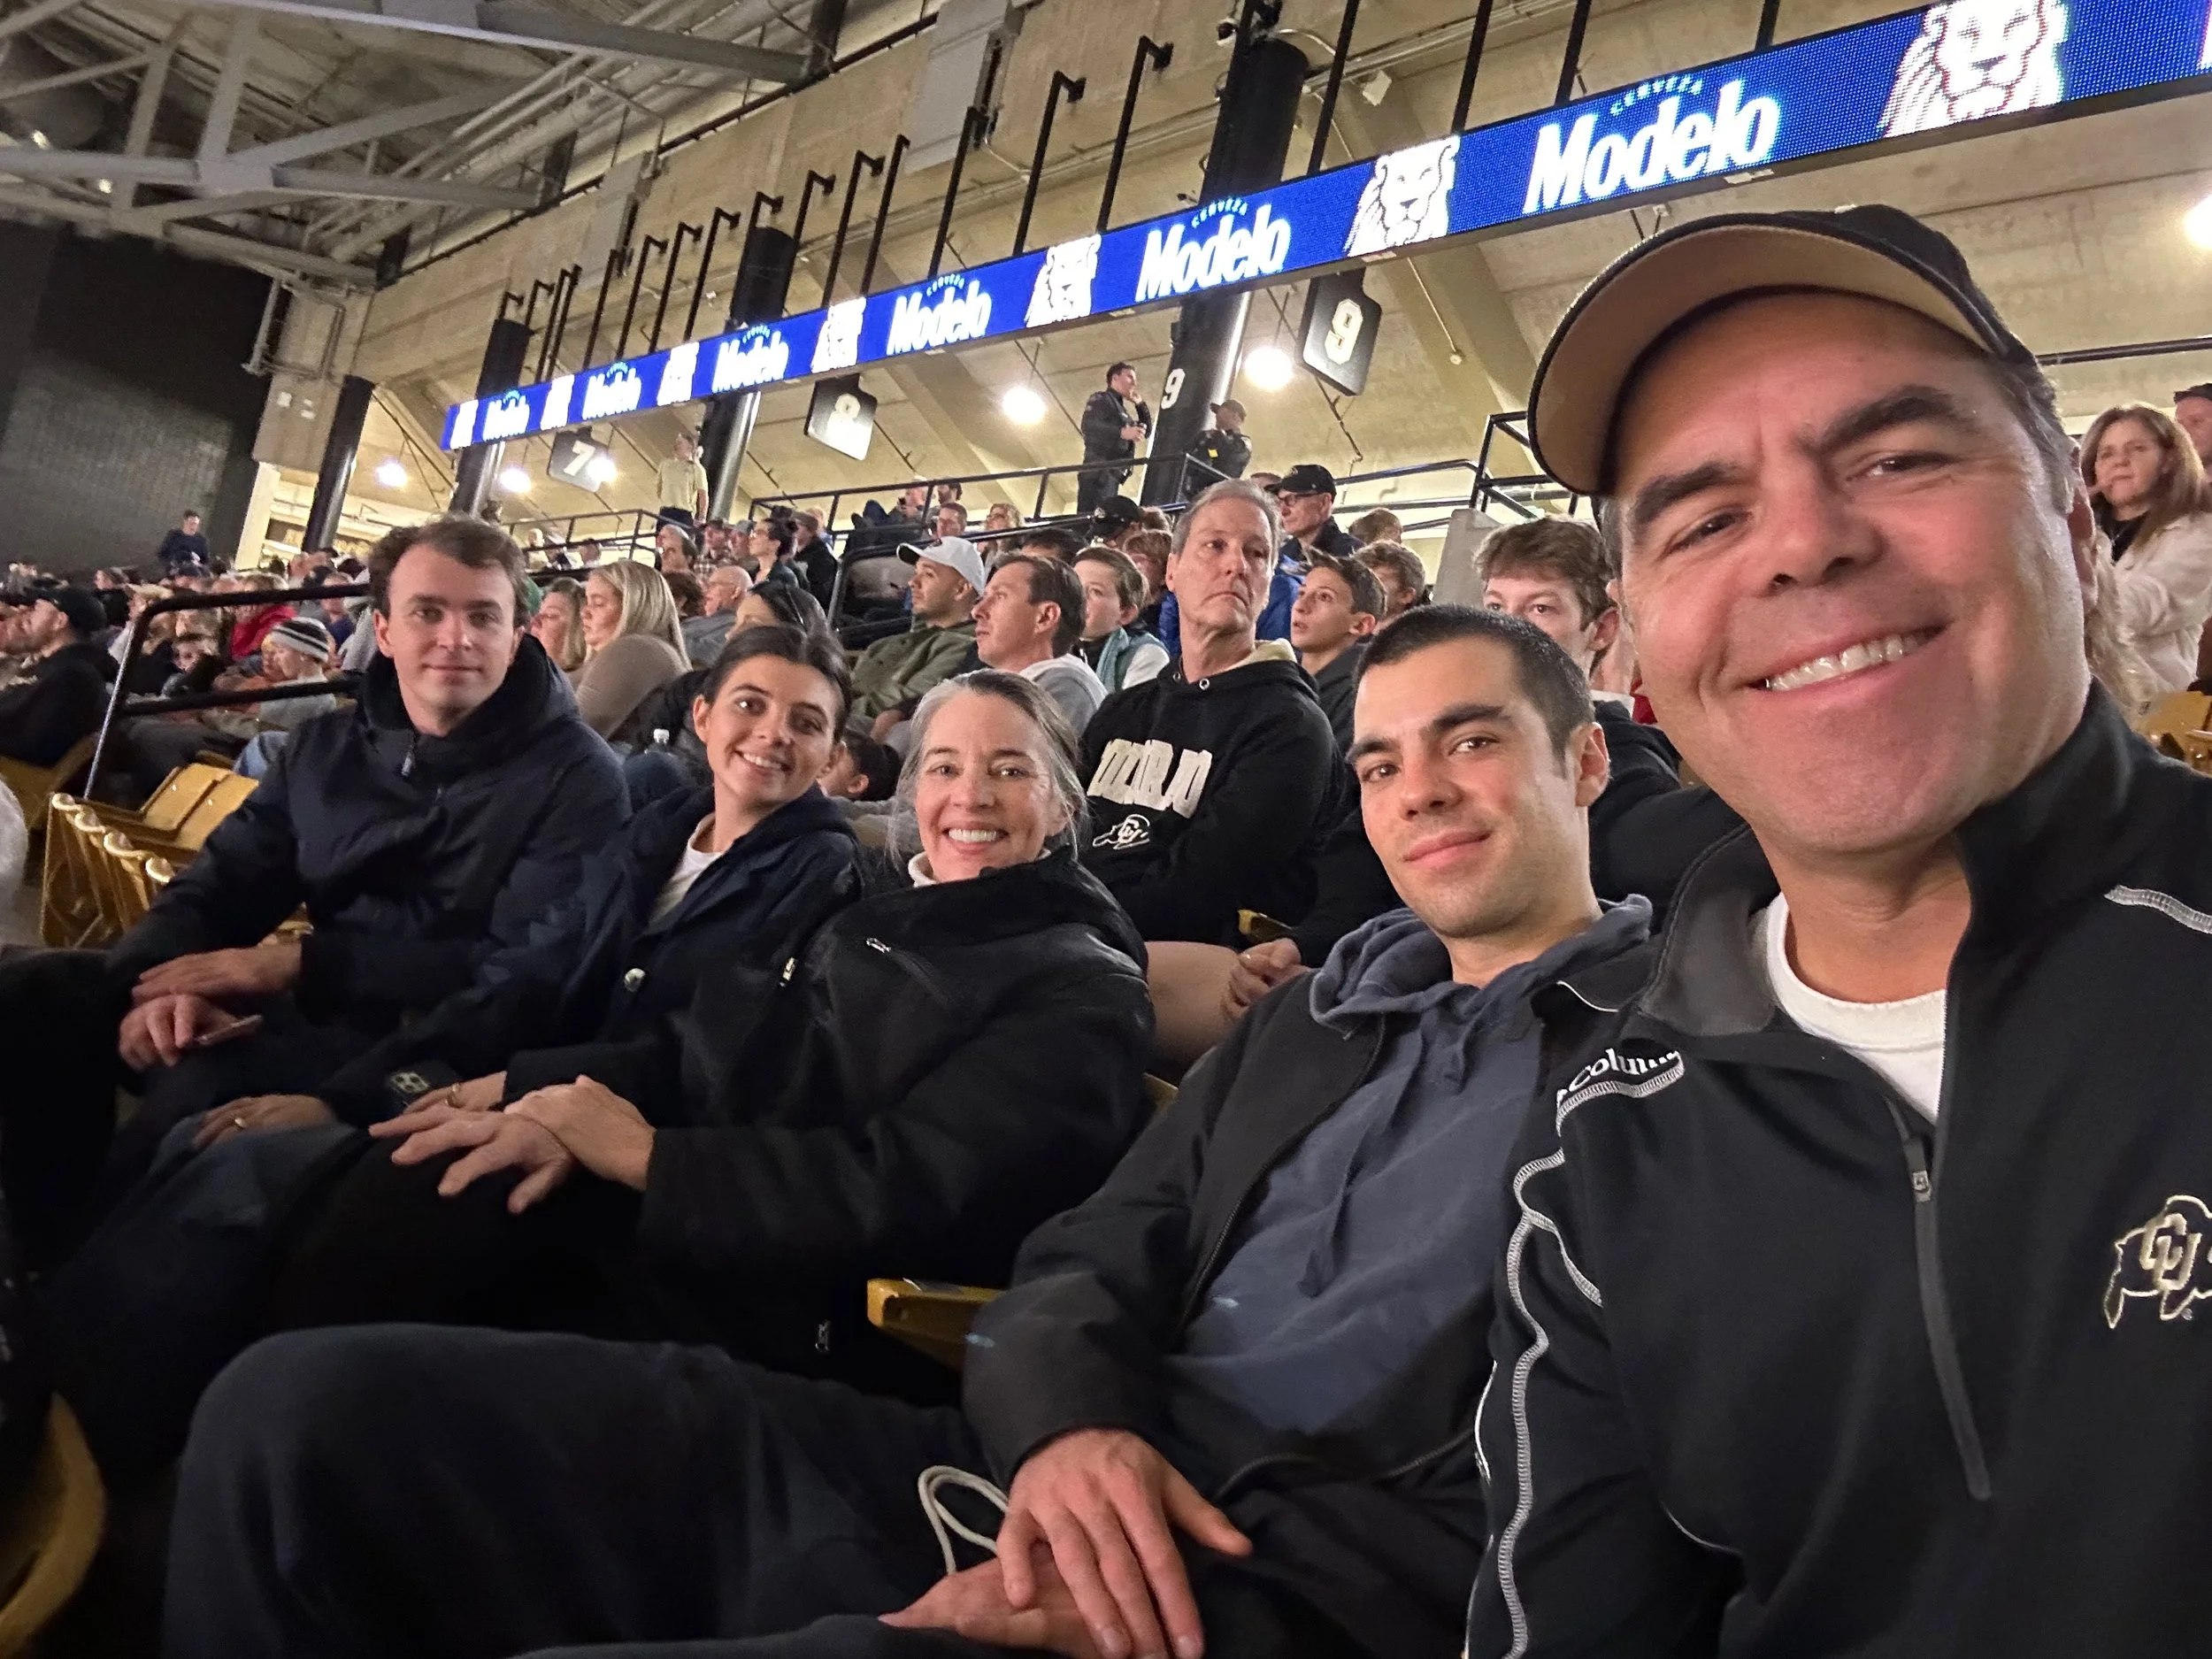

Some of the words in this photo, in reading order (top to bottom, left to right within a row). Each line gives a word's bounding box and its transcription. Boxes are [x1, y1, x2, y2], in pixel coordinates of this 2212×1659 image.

[1522, 78, 1781, 215] Modelo
[1135, 204, 1292, 303] Modelo
[886, 280, 992, 356] Modelo
[1324, 298, 1364, 365] 9
[1160, 368, 1186, 410] 9
[563, 440, 596, 477] 7
[2139, 1212, 2203, 1291] CU
